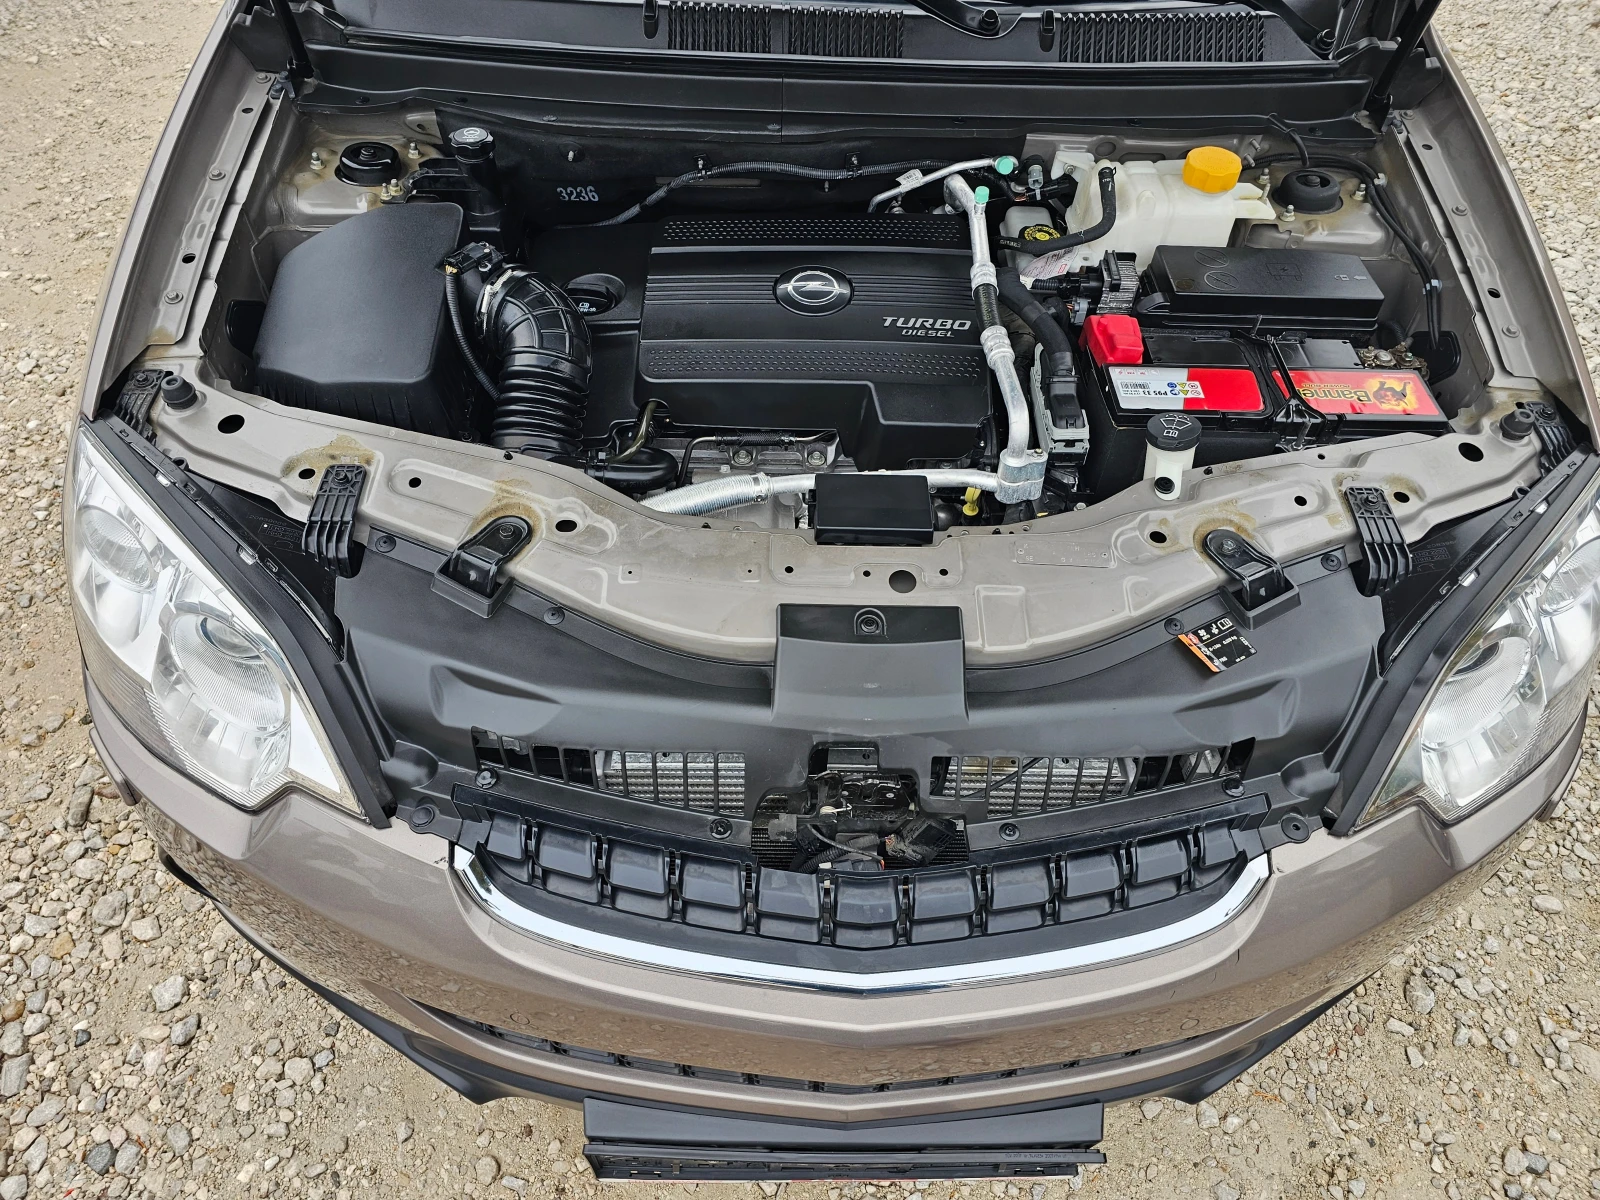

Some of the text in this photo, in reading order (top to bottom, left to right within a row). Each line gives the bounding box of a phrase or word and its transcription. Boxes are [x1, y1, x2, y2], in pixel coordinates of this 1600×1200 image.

[556, 186, 599, 202] 3236
[882, 316, 972, 331] TURBO
[901, 329, 955, 338] DIESEL
